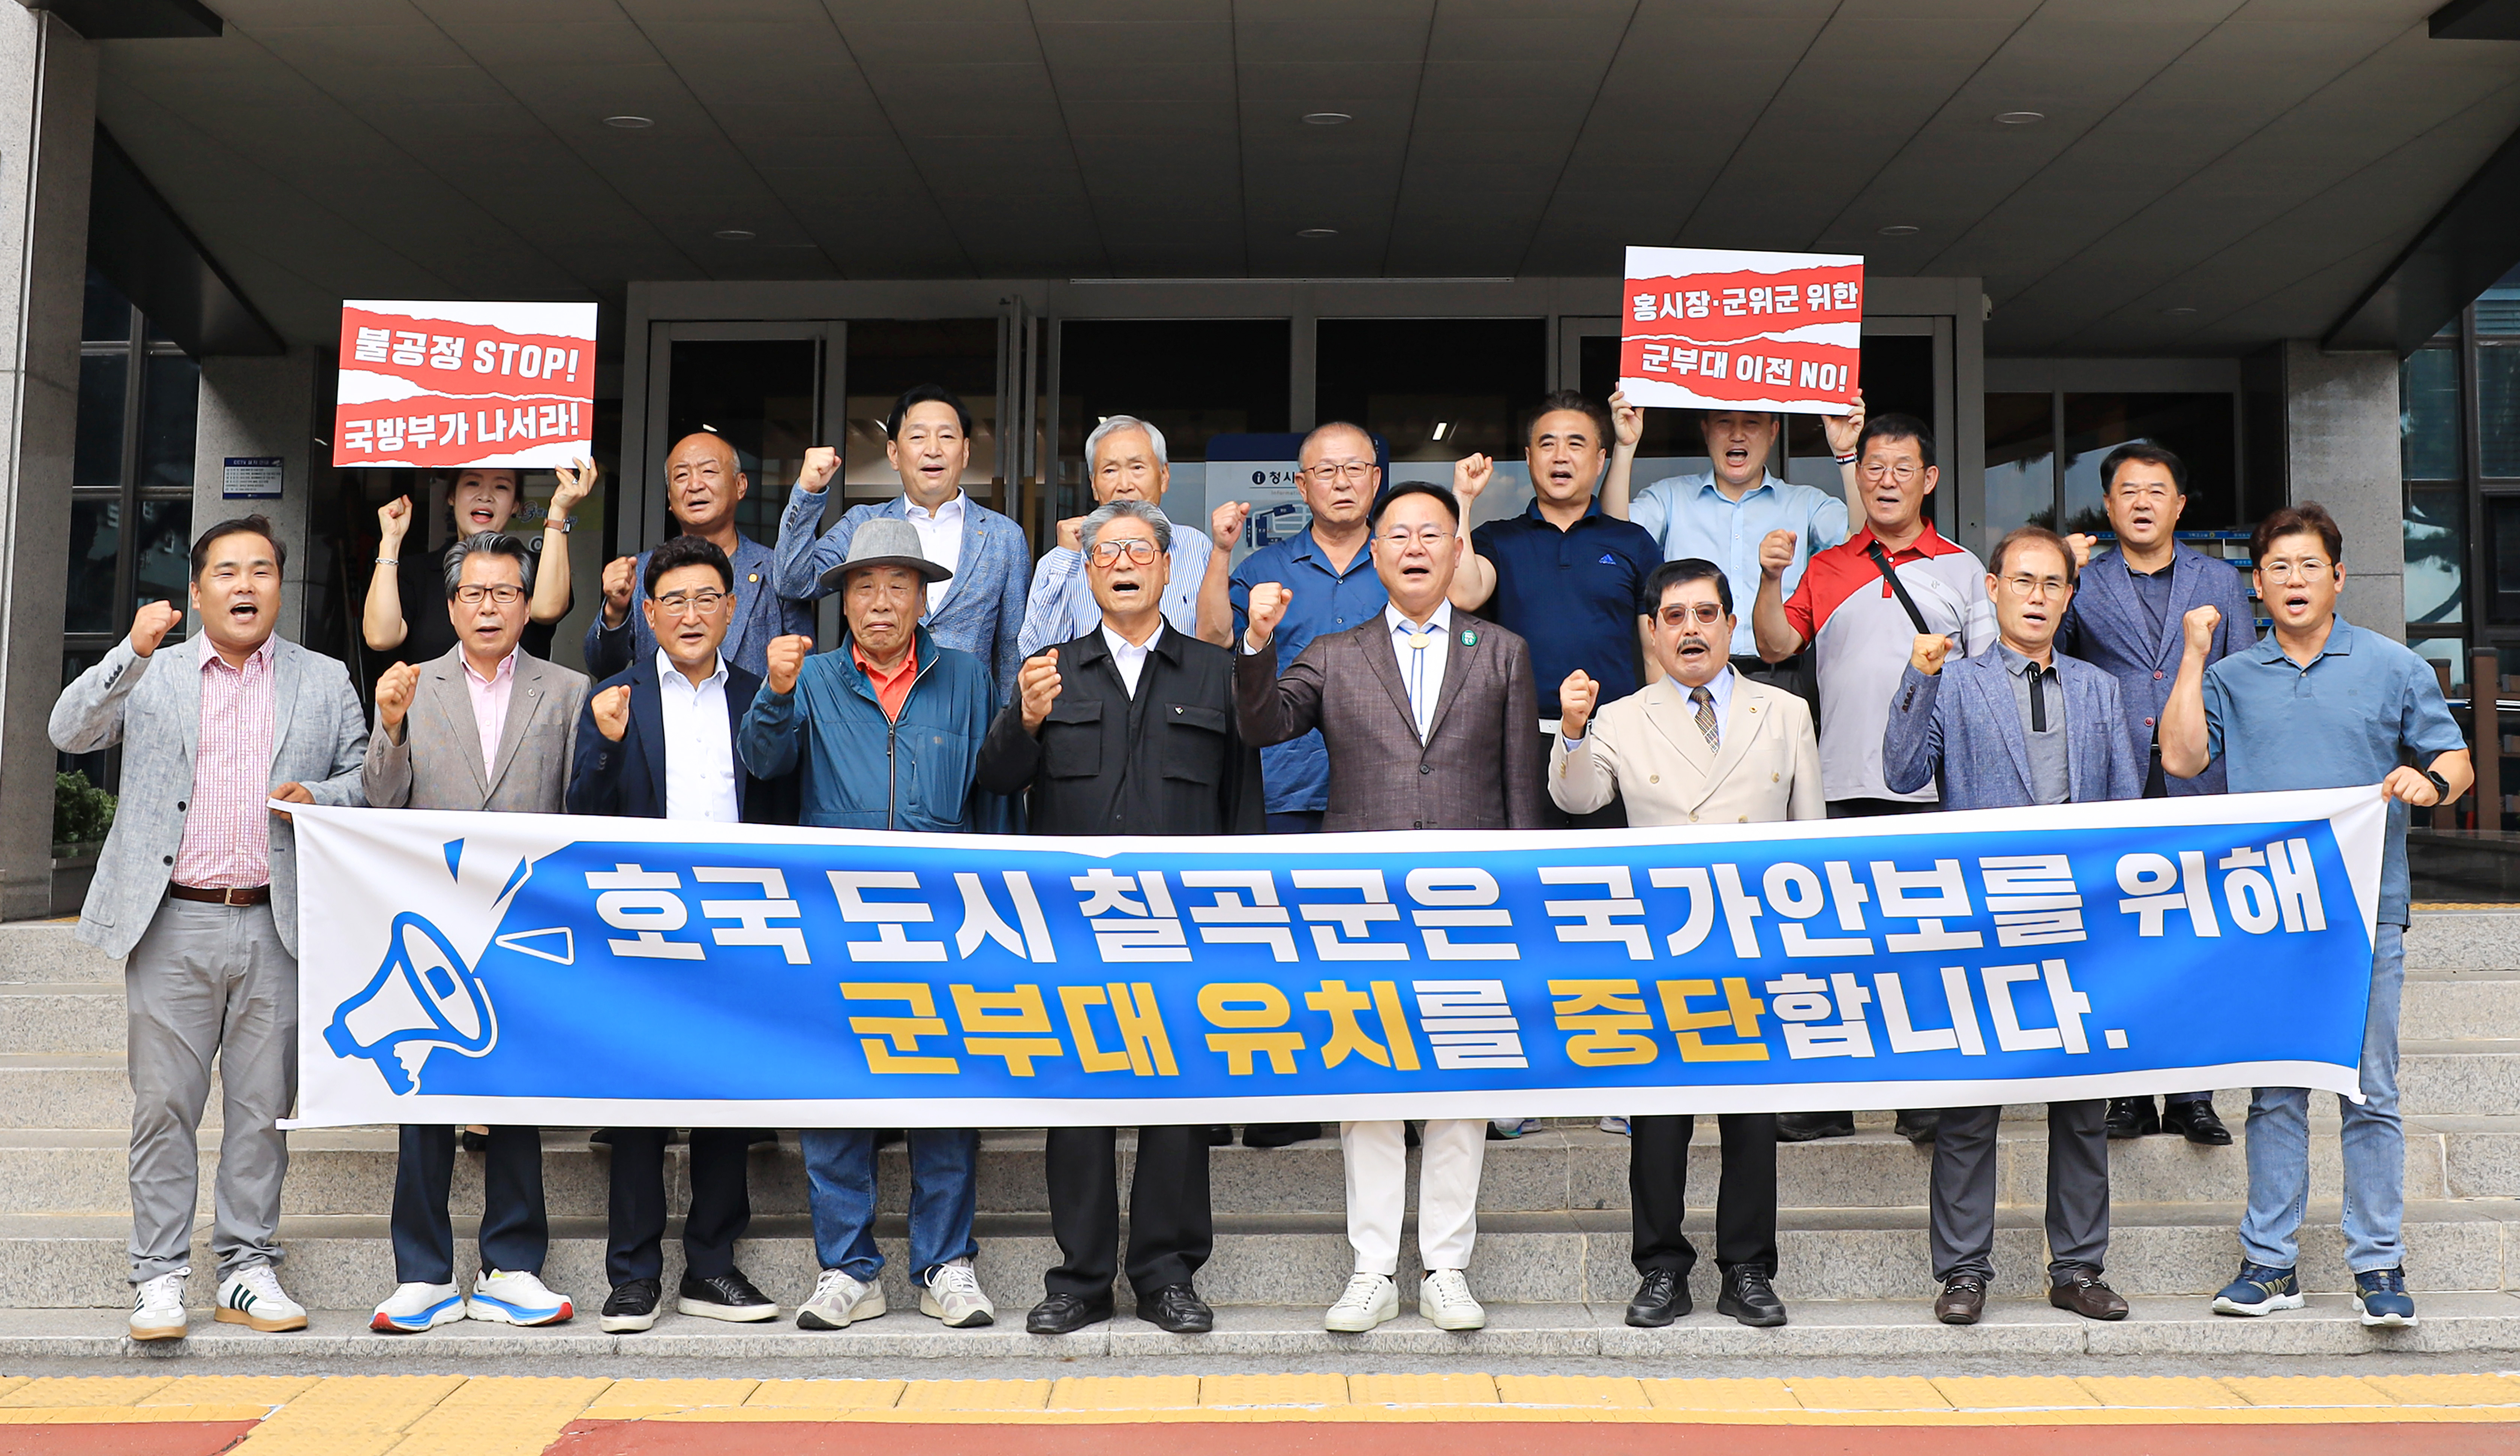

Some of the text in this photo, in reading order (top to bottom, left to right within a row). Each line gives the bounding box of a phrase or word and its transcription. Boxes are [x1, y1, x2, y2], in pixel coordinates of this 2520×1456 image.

[1633, 282, 1858, 322] 홍시장·군위군 위한
[355, 327, 579, 382] 불공정 STOP!
[1642, 344, 1848, 392] 군부대 이전 NO!
[345, 402, 579, 453] 국방부가 나서라!
[584, 838, 2327, 965] 호국 도시 칠곡군은 국가안보를 위해
[839, 959, 2129, 1077] 군부대 유치를 중단합니다.
